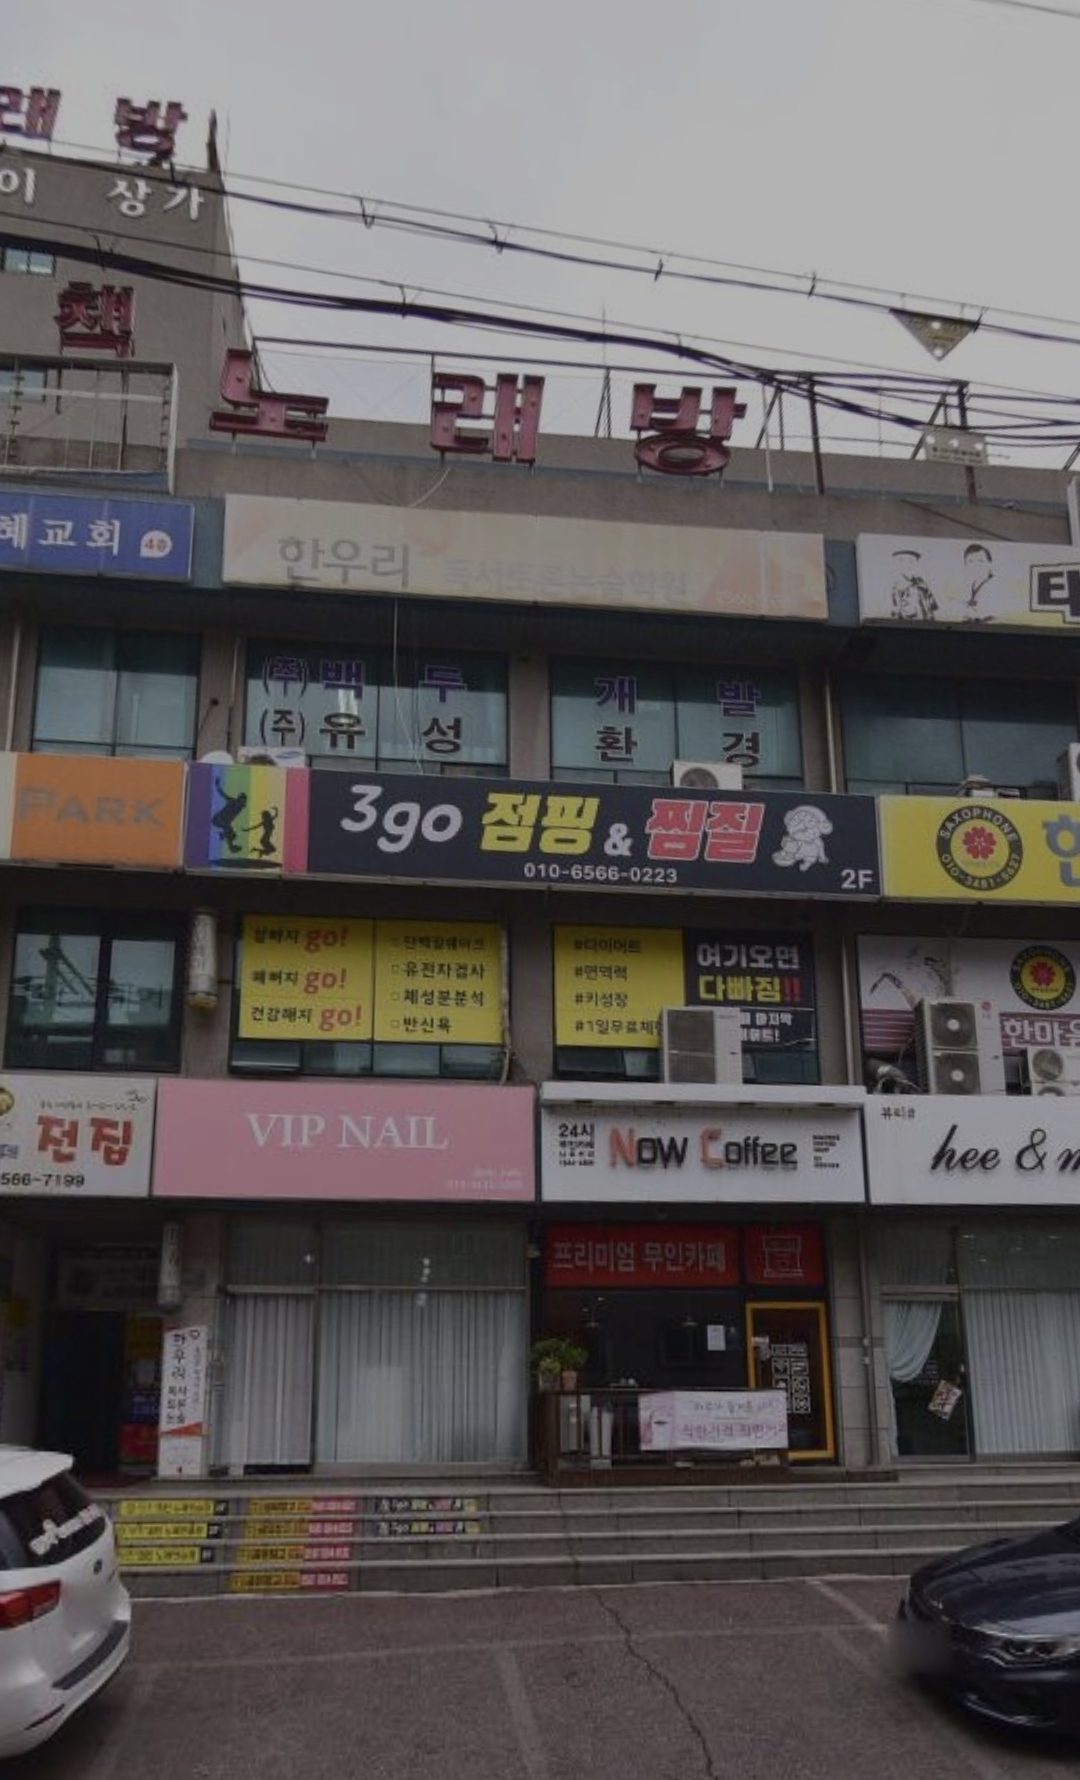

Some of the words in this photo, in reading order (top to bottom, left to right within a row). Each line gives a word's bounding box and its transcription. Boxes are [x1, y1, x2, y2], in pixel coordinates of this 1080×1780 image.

[107, 178, 205, 221] 상가
[278, 536, 410, 589] 한우리
[18, 784, 165, 828] PARK
[340, 784, 463, 853] 3go
[480, 791, 600, 855] 점핑
[604, 823, 634, 857] &
[644, 798, 766, 864] 찜질
[524, 862, 678, 884] 010-6566-0223
[840, 869, 874, 889] 2F
[304, 925, 350, 954] go!
[696, 943, 801, 970] 여기오면
[304, 967, 347, 994] go!
[319, 1004, 363, 1032] go!
[37, 1115, 133, 1166] 전집
[245, 1112, 325, 1148] VIP
[336, 1115, 450, 1150] NAIL
[700, 1126, 798, 1168] Coffee
[931, 1124, 1001, 1170] hee
[1015, 1128, 1048, 1170] &
[553, 1240, 635, 1273] 프리미엄
[643, 1240, 726, 1273] 무인카페
